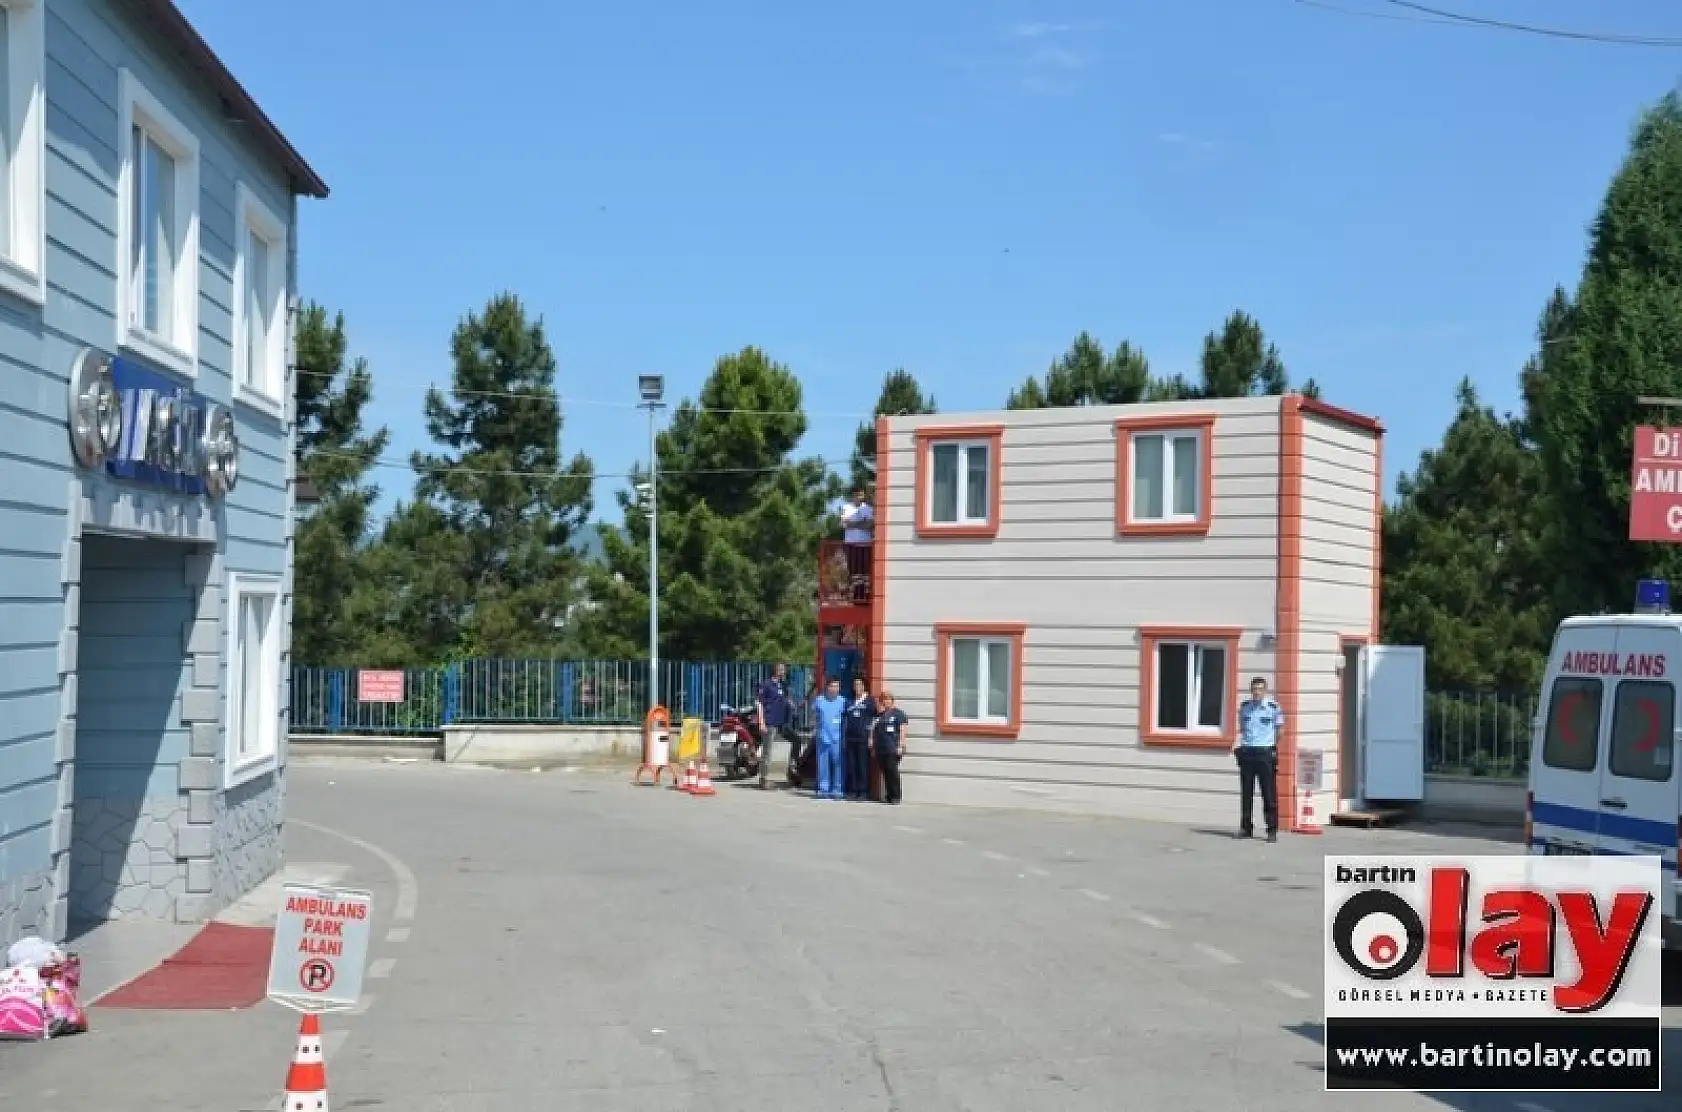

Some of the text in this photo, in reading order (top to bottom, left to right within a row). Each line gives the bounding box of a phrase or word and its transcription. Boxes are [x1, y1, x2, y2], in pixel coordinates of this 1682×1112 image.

[1562, 650, 1666, 677] AMBULANS
[285, 896, 367, 920] AMBULANS
[304, 918, 344, 937] PARK
[298, 937, 344, 957] ALANI
